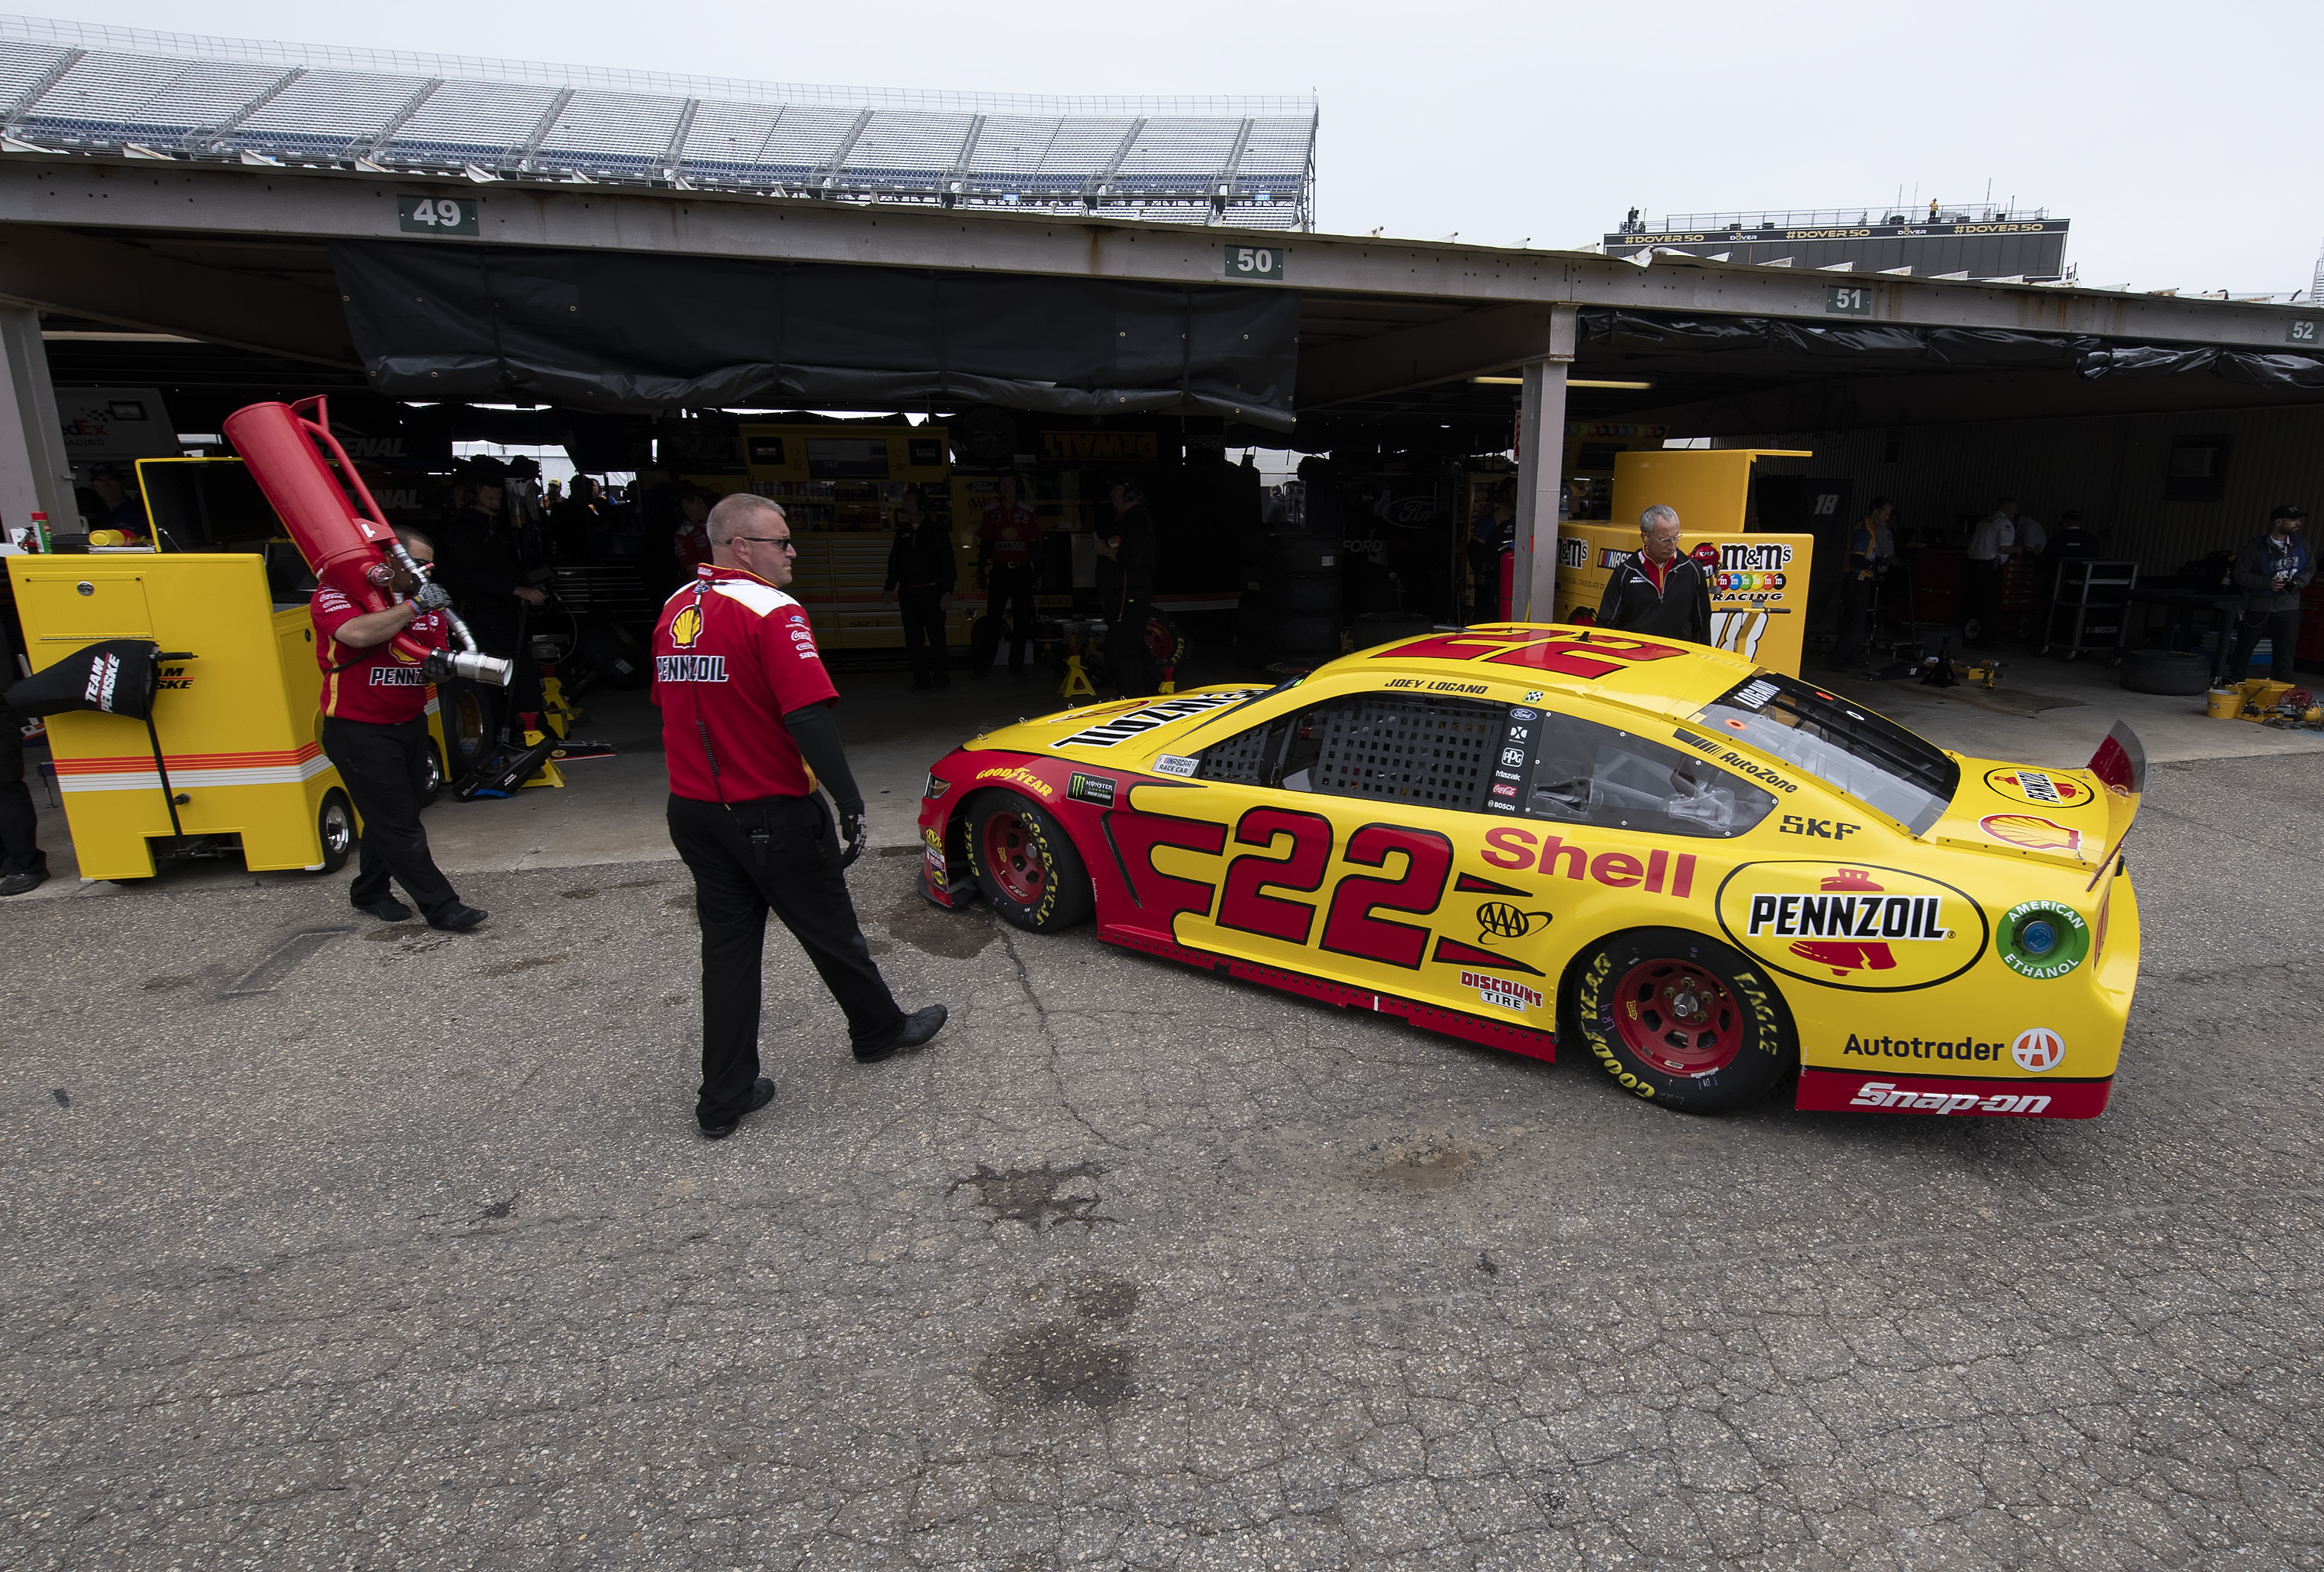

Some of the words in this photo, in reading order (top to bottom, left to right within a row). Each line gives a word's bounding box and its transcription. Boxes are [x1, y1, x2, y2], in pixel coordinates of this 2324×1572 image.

[414, 199, 460, 226] 49
[1625, 235, 1682, 244] #DOVER
[1786, 231, 1847, 239] #DOVER
[1953, 225, 2019, 234] #DOVER
[1237, 248, 1272, 272] 50
[1836, 288, 1861, 309] 51
[2293, 321, 2314, 339] 52
[1814, 494, 1839, 514] 18
[1343, 540, 1383, 552] FORD
[1712, 593, 1783, 601] RACING
[1170, 637, 1185, 665] EAGLE
[85, 656, 106, 702] TEAM
[100, 653, 120, 713] PENSKE
[157, 680, 193, 689] SKE
[369, 667, 429, 686] PENNZ
[1384, 679, 1425, 688] JOEY
[1426, 680, 1488, 694] LOGANO
[1733, 680, 1781, 709] LOGANO
[1168, 758, 1192, 768] NASCAR
[1504, 749, 1522, 765] PPG
[976, 767, 1053, 797] GOODYEAR
[1495, 771, 1520, 781] Mazak
[1720, 752, 1798, 793] AutoZone
[1085, 780, 1113, 791] MONSTER
[1494, 801, 1516, 811] BOSCH
[1779, 814, 1861, 840] SKF
[1480, 827, 1697, 899] Shell
[1216, 805, 1454, 971] 22
[1746, 893, 1949, 942] PENNZOIL
[2008, 900, 2085, 929] AMERICAN
[2004, 953, 2079, 978] ETHANOL
[1461, 971, 1543, 1007] DISCOUNT
[1484, 991, 1521, 1010] TIRE
[1581, 952, 1655, 1097] GOODYEAR
[1733, 972, 1777, 1056] EAGLE
[1843, 1033, 2005, 1061] Autotrader
[1849, 1082, 2052, 1115] Snap-on
